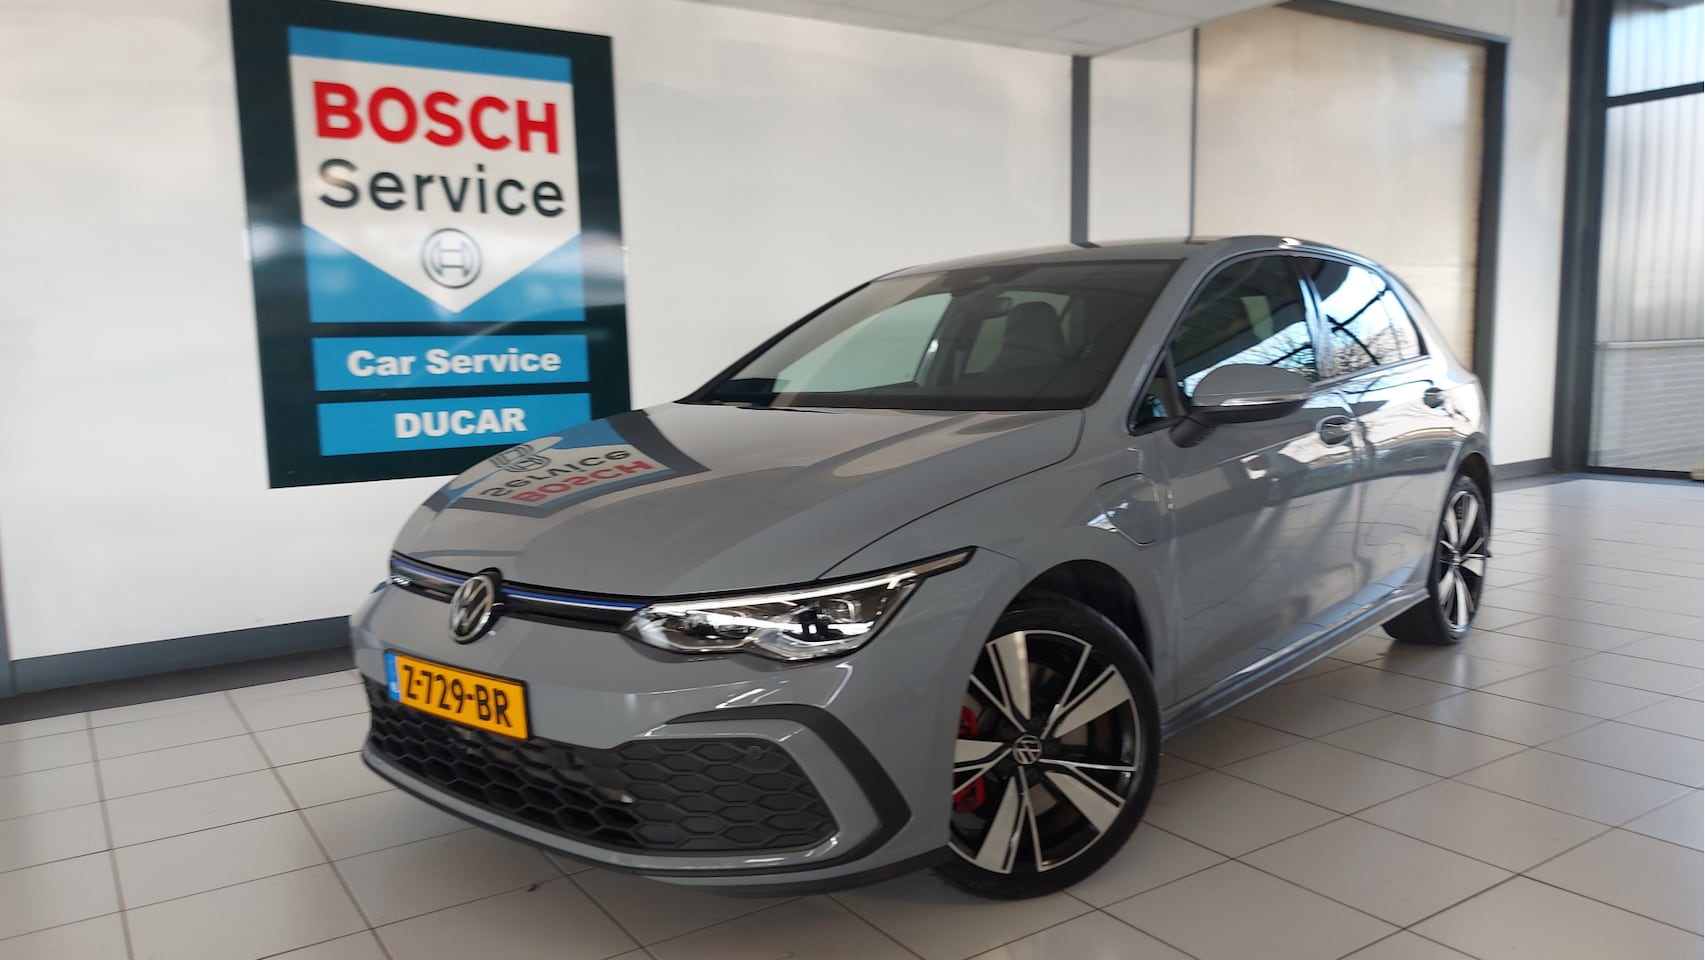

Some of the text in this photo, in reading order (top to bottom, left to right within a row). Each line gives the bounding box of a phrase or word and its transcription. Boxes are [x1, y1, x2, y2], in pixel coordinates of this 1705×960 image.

[312, 81, 559, 154] BOSCH
[319, 158, 565, 217] Service
[347, 348, 562, 376] Car Service
[395, 408, 527, 439] DUCAR
[403, 665, 512, 728] Z-729-BR
